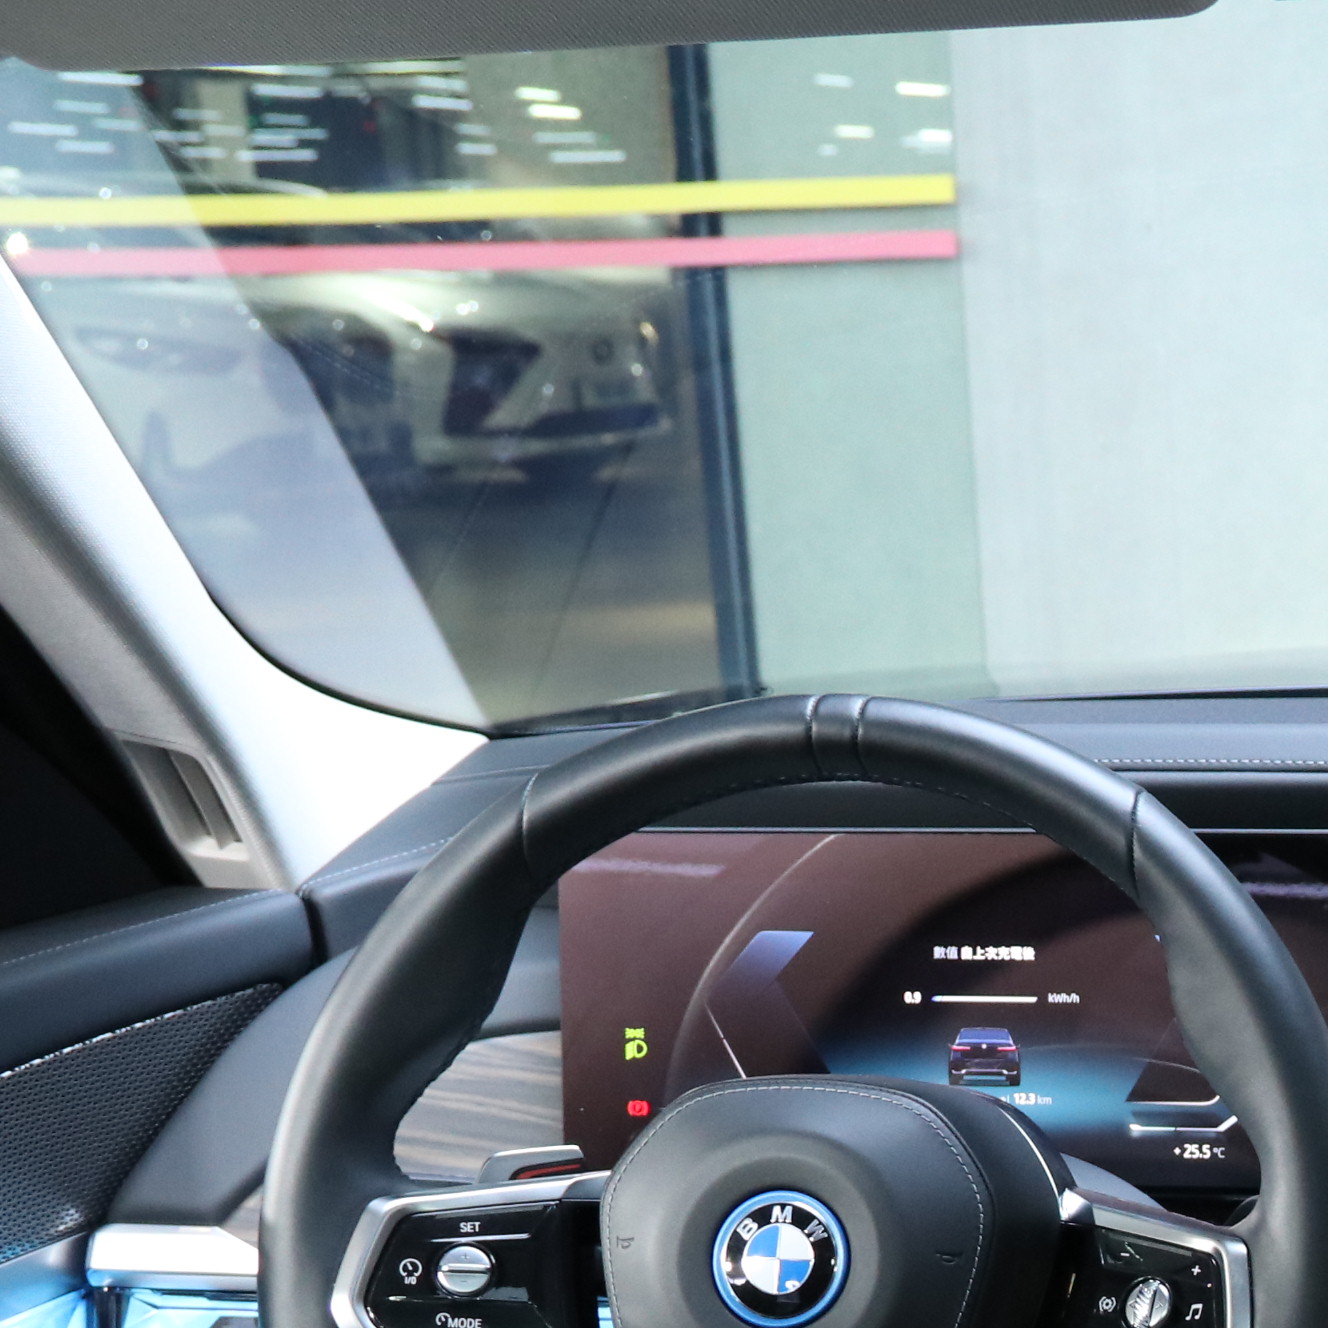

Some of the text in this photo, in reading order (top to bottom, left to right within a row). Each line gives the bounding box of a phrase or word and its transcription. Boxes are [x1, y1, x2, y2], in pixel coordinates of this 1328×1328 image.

[1048, 992, 1080, 1004] kWh/h
[1013, 1092, 1036, 1105] 12.3
[1037, 1094, 1052, 1105] km
[459, 1221, 481, 1233] SET
[736, 1204, 829, 1243] BMW
